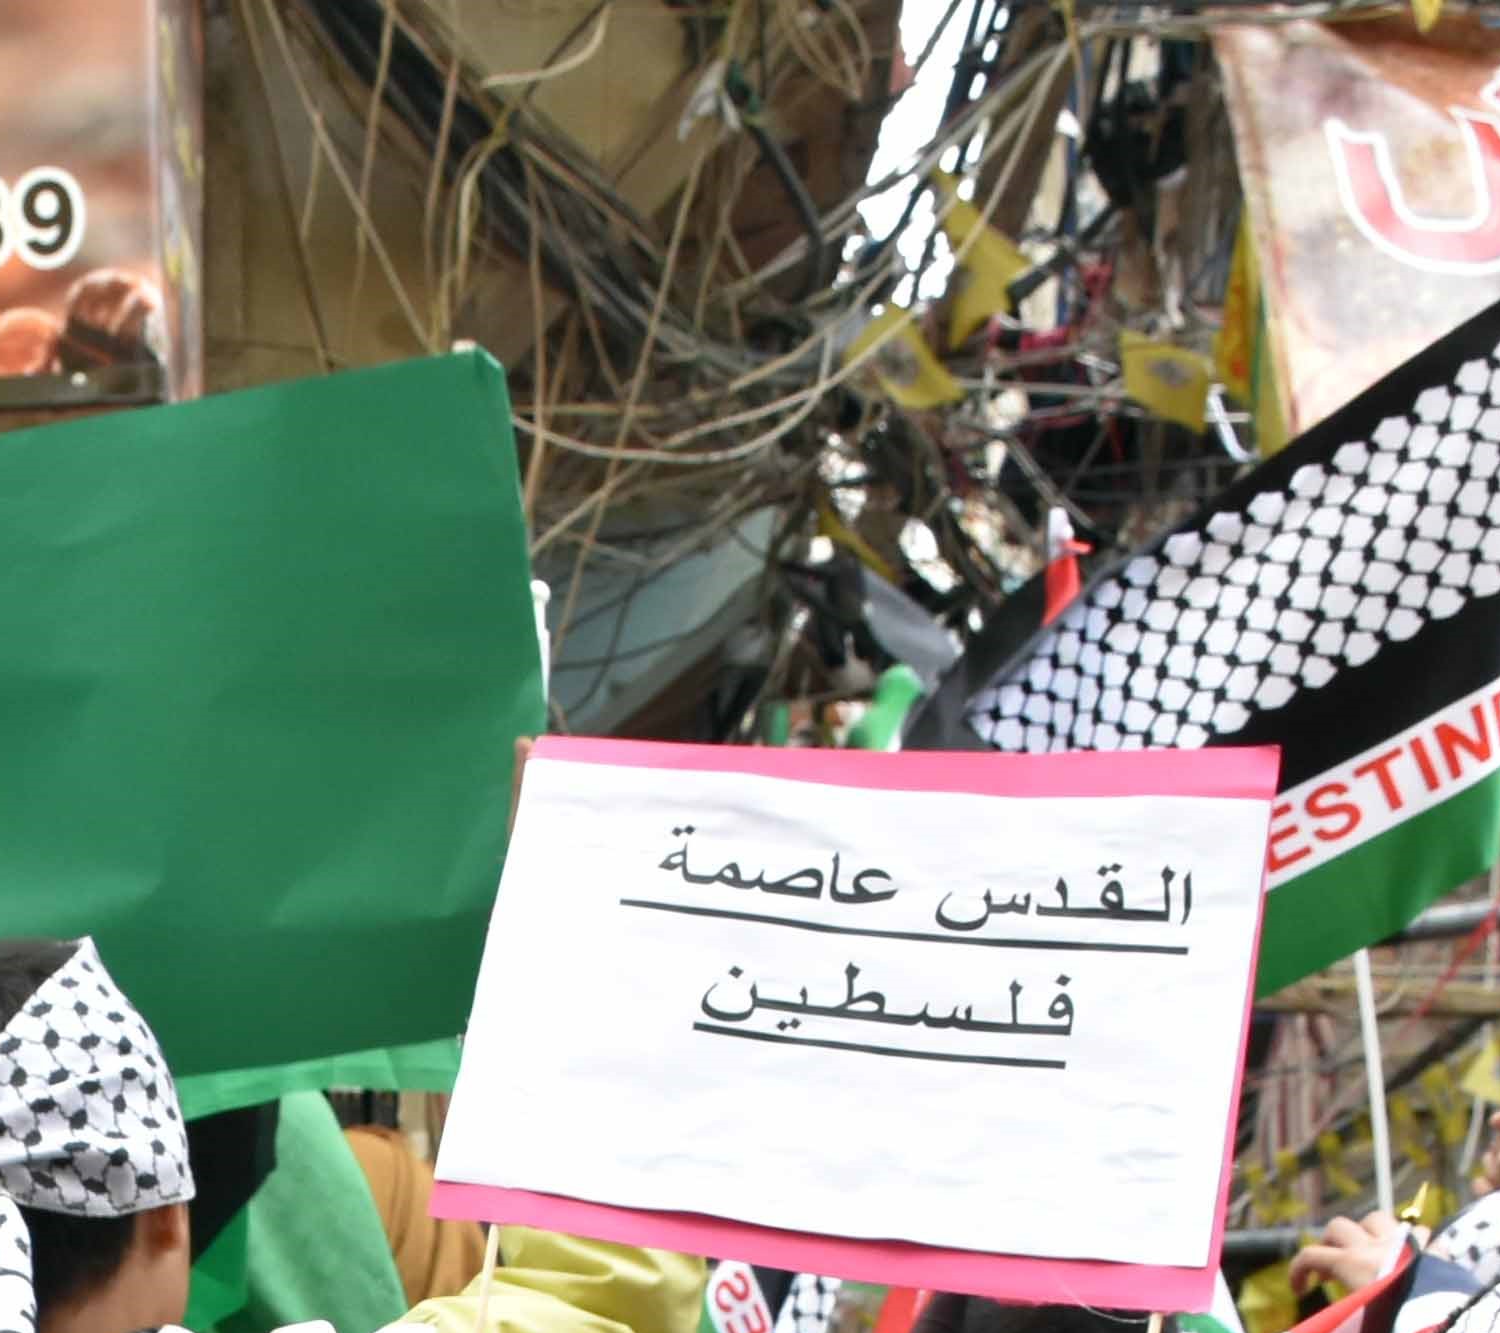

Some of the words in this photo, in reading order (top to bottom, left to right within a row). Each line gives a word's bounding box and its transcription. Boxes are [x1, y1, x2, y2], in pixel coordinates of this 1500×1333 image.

[657, 825, 899, 906] عاصمة
[935, 862, 1194, 929] القدس
[700, 961, 1076, 1037] فلسطين
